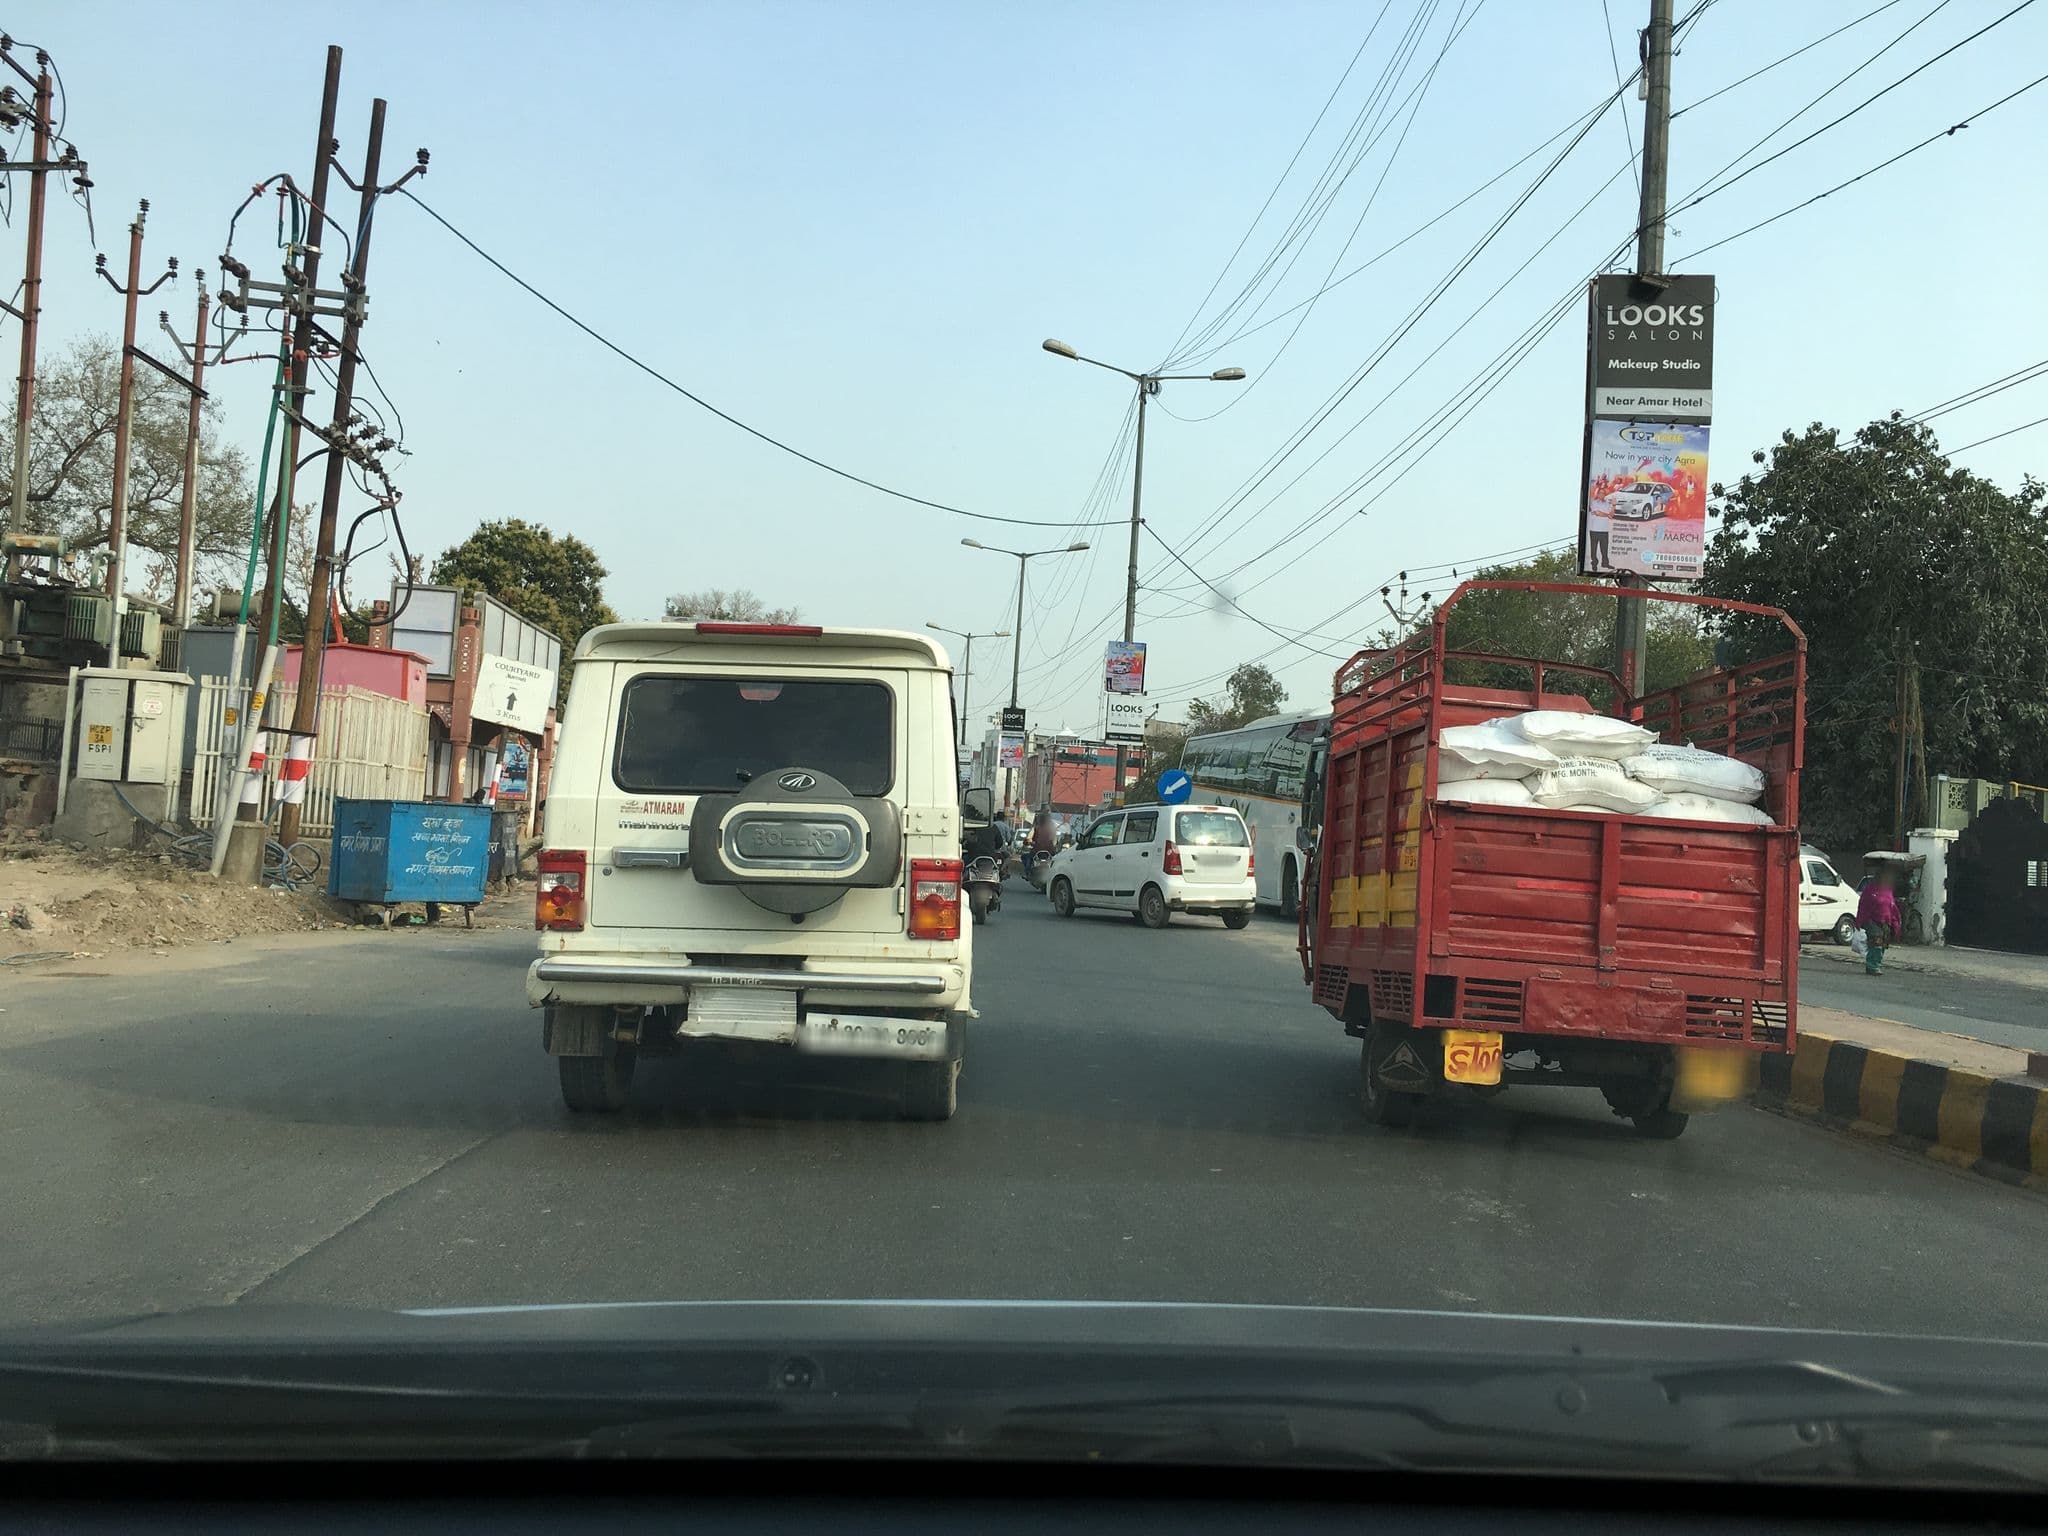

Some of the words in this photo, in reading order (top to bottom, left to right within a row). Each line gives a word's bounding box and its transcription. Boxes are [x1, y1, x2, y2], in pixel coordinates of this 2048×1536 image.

[1607, 305, 1704, 326] LOOKS
[1608, 330, 1703, 341] SALON
[1608, 358, 1658, 371] Makeup
[1662, 358, 1701, 370] Studio
[1606, 396, 1635, 406] Near
[1638, 396, 1669, 407] Amar
[1672, 397, 1703, 407] Hotel
[1605, 451, 1625, 460] Now
[1628, 452, 1635, 460] in
[1637, 454, 1656, 464] your
[1658, 455, 1672, 465] city
[1674, 456, 1696, 467] Agra
[1663, 533, 1699, 543] MARCH
[495, 662, 541, 679] COURTYARD
[1111, 704, 1143, 714] LOOKS
[502, 711, 521, 721] Kms
[1588, 761, 1619, 773] MONTHS
[643, 801, 685, 815] ATMARAM
